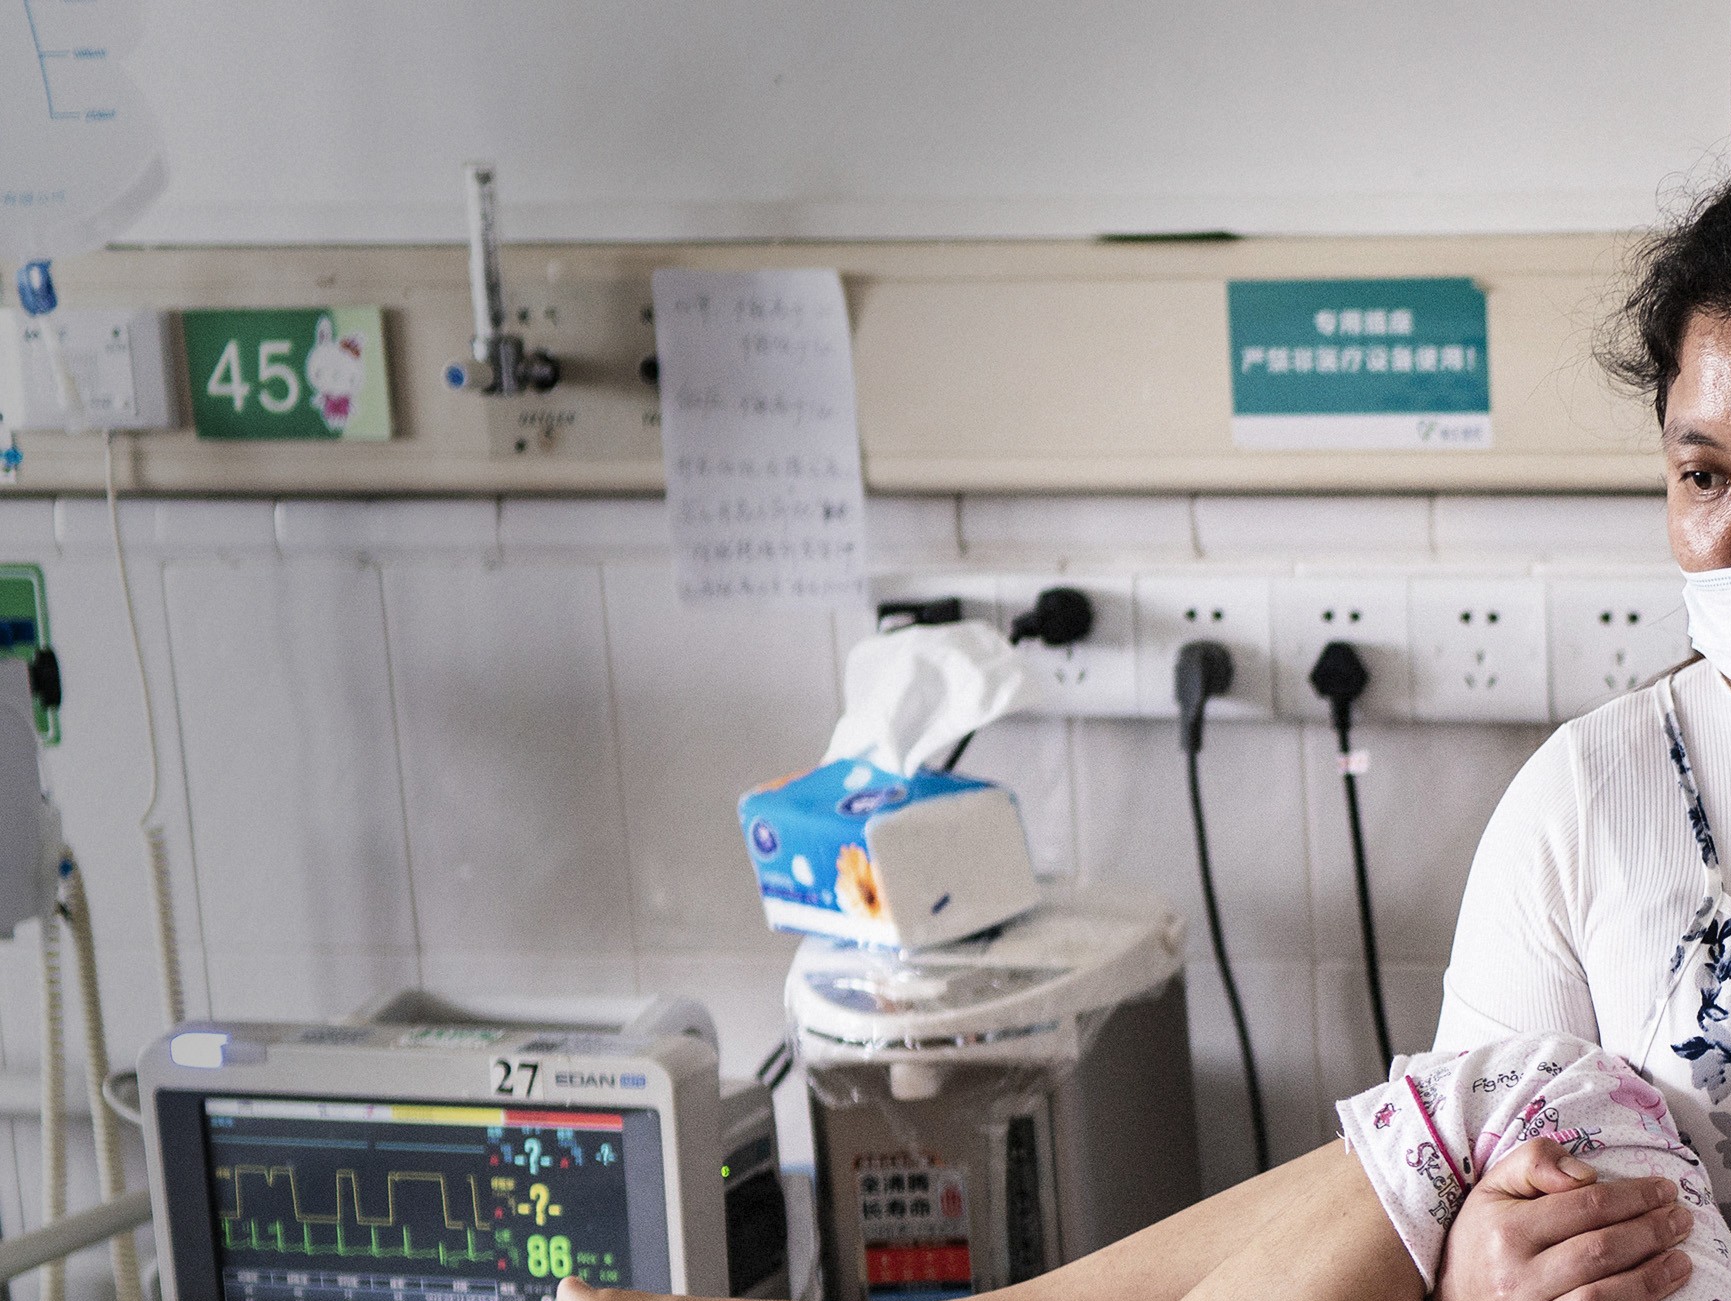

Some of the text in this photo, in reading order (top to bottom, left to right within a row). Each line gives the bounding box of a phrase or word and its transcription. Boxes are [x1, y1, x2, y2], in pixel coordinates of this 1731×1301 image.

[204, 338, 301, 414] 45
[494, 1058, 539, 1099] 27
[555, 1069, 616, 1088] EDAN
